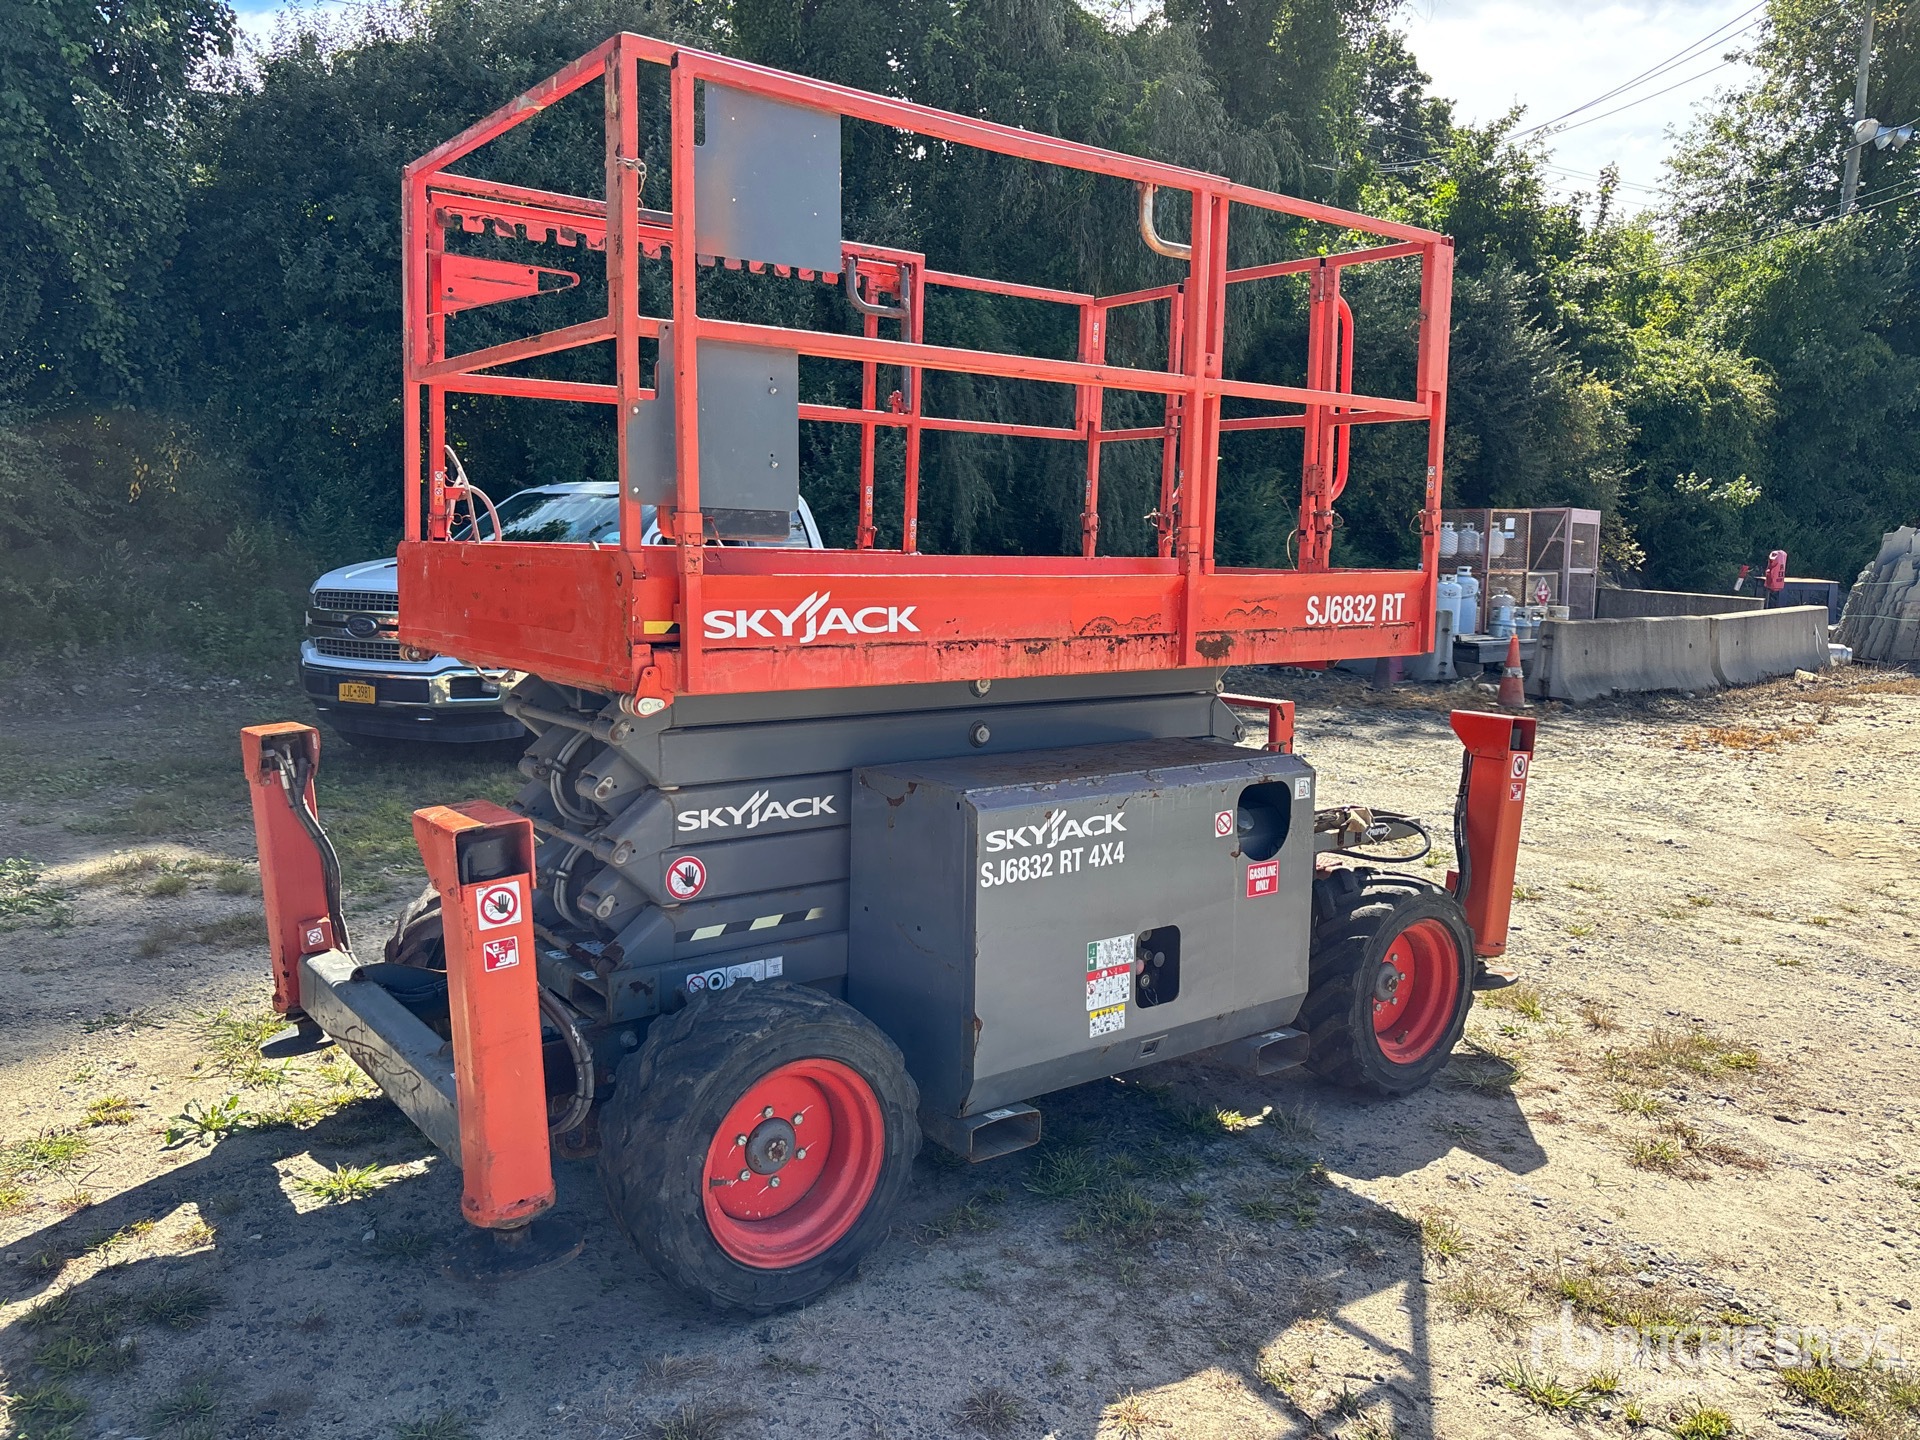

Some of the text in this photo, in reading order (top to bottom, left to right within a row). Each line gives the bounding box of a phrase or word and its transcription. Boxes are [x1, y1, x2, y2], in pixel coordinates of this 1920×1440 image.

[703, 591, 921, 643] SKYJACK
[1305, 592, 1406, 625] SJ6832 RT
[677, 789, 837, 831] SKYJACK
[985, 808, 1128, 852] SKYJACK
[980, 841, 1125, 888] SJ6832 RT 4X4
[1249, 865, 1277, 880] GASOLINE
[1255, 879, 1270, 892] ONLY
